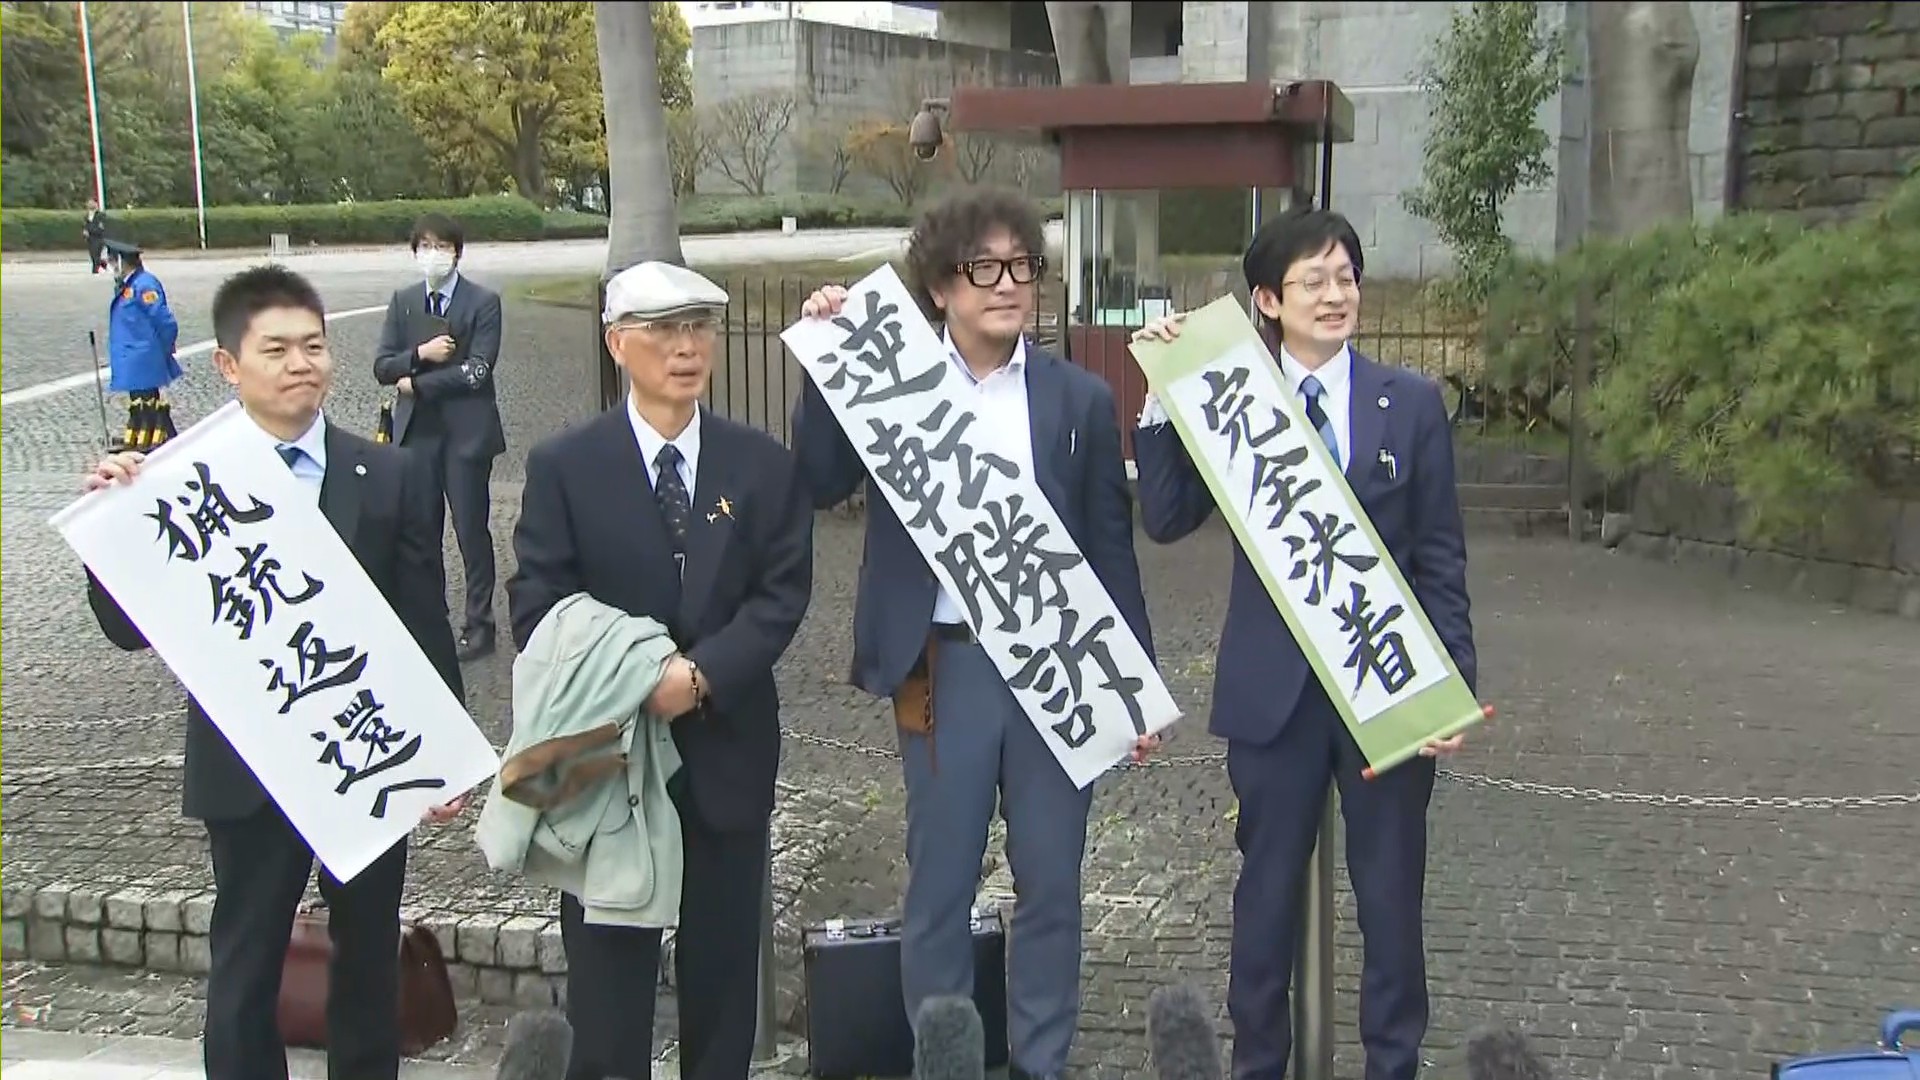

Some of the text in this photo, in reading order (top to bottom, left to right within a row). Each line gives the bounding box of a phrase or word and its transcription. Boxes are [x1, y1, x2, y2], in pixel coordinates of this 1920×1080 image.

[143, 462, 446, 818] 猟銃返還へ
[817, 290, 1146, 749] 逆転勝訴
[1201, 367, 1417, 701] 完全決着
